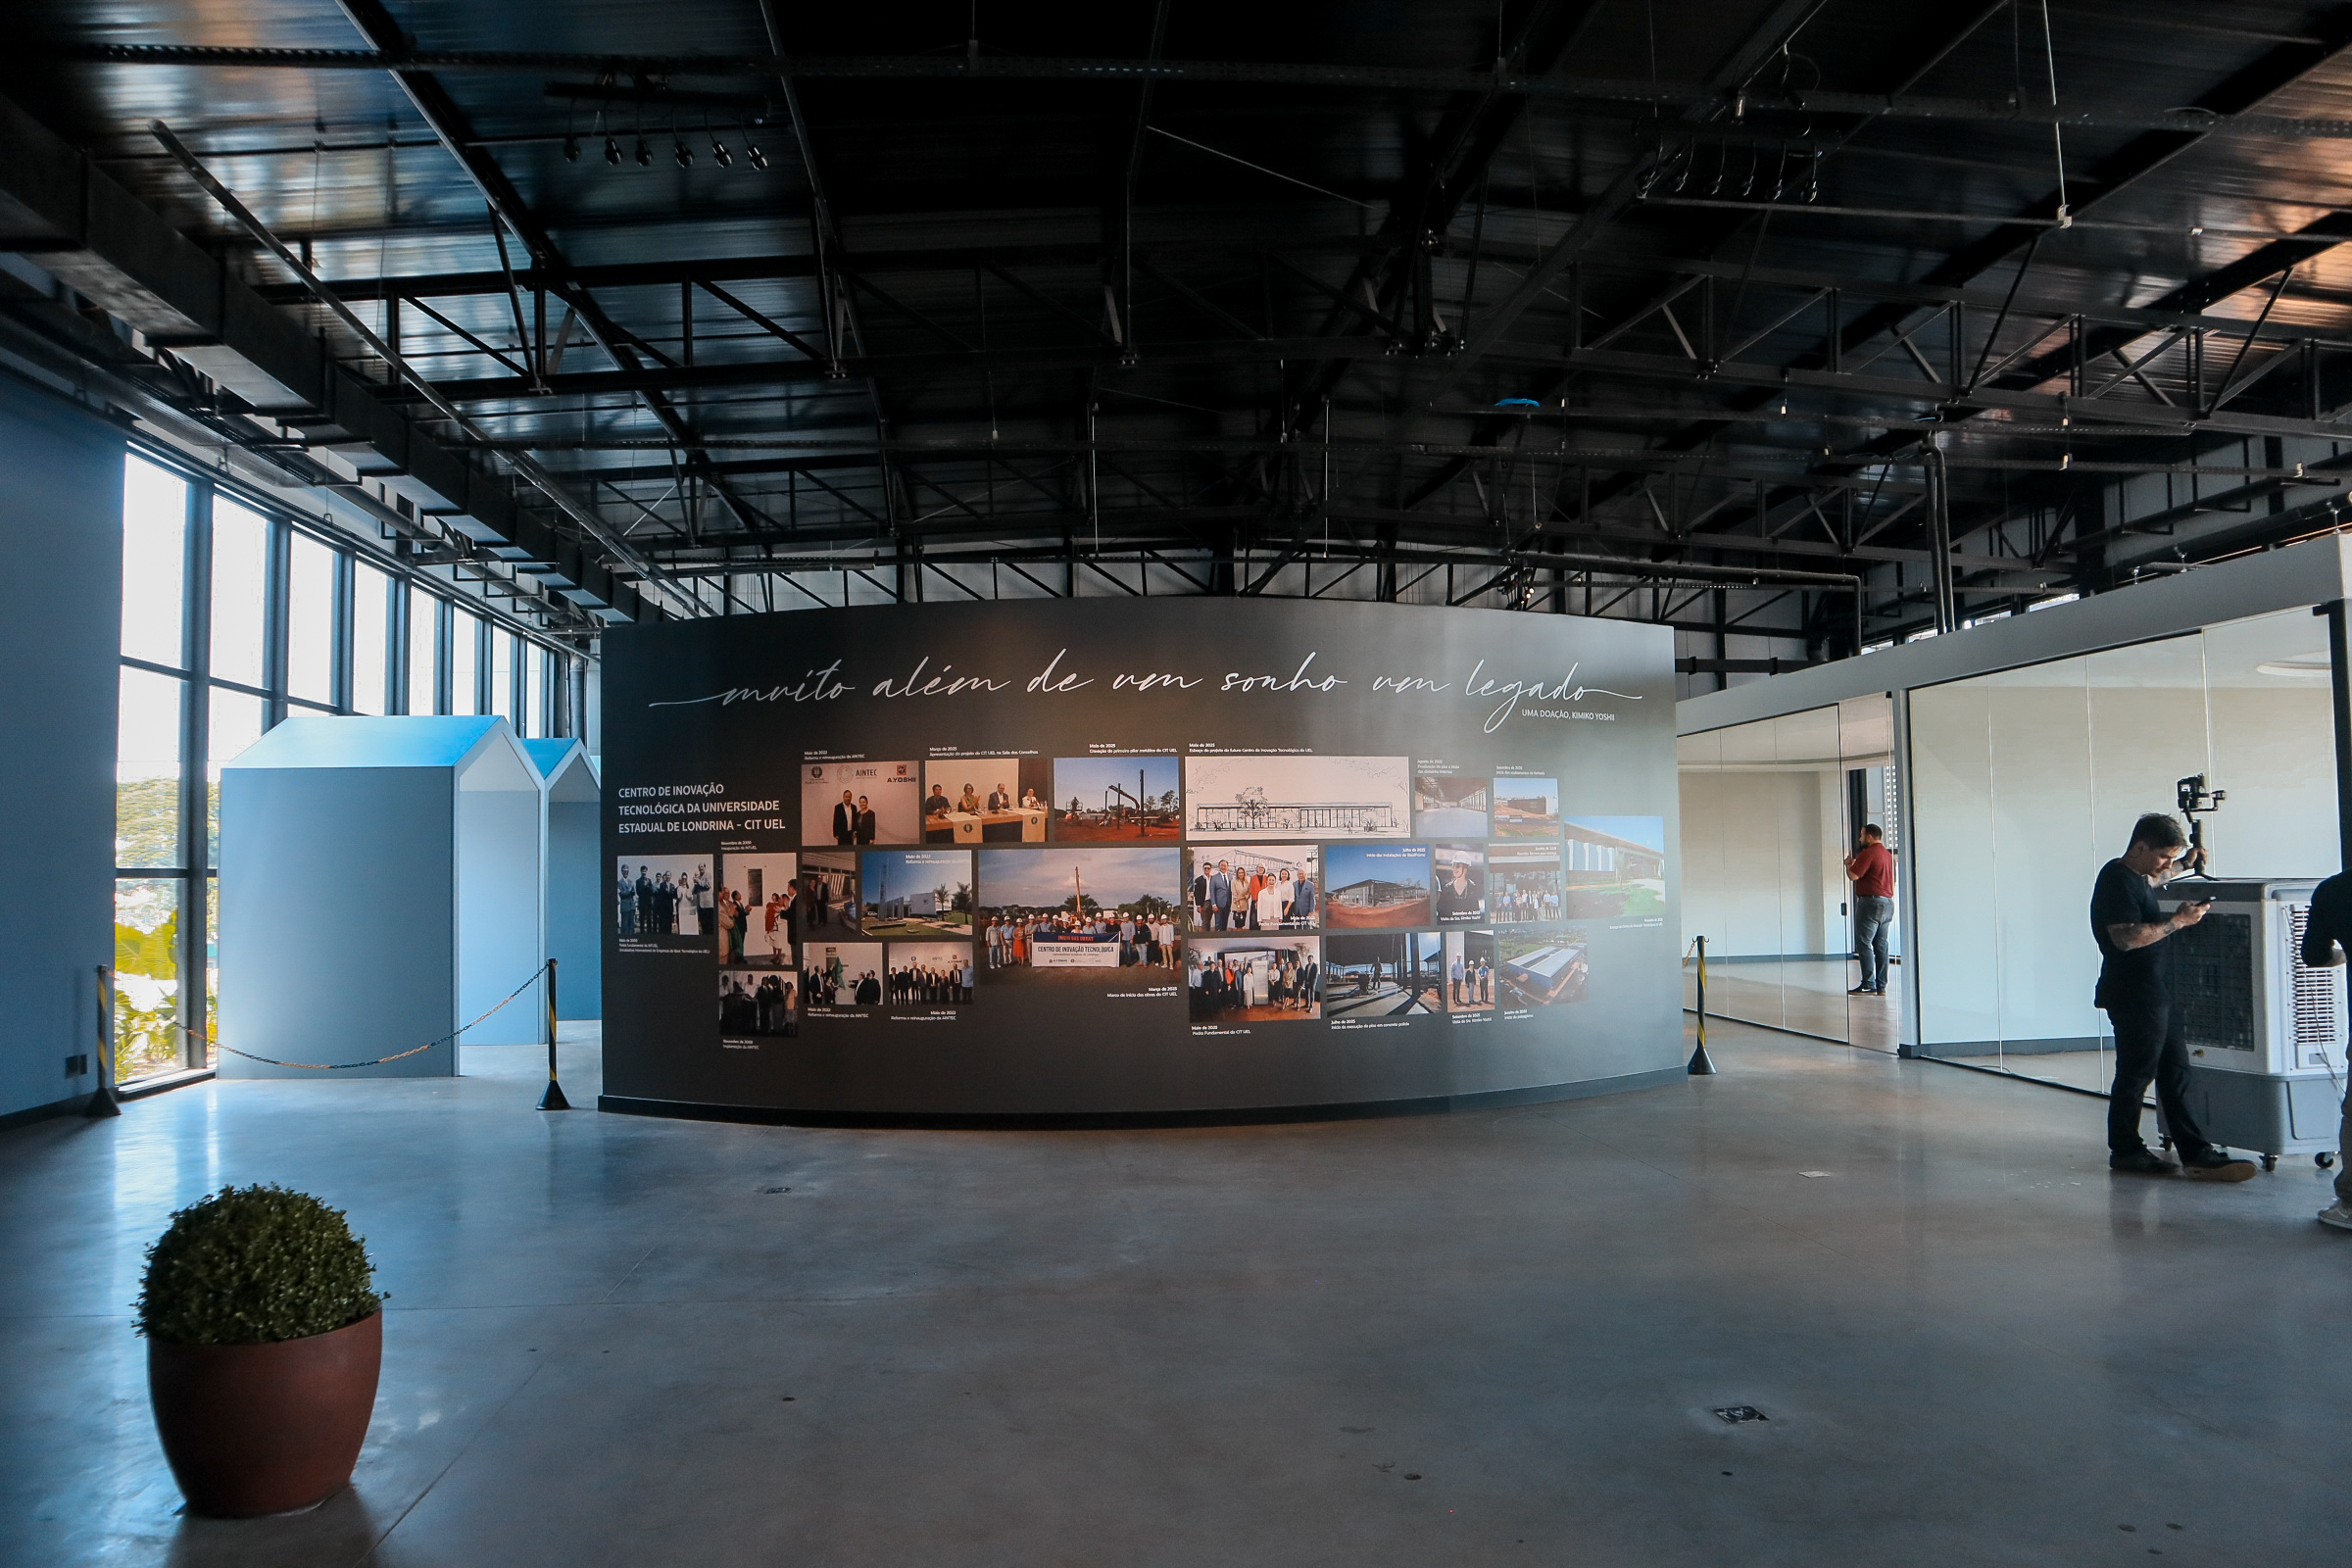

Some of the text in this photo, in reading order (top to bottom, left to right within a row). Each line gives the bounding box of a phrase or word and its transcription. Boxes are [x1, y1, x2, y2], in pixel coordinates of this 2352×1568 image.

[649, 649, 1642, 733] muito além de um sonho um legado
[1521, 709, 1539, 717] UMA
[1540, 709, 1571, 720] DOAÇÃO,
[1572, 711, 1594, 721] KIMIKO
[618, 782, 724, 798] CENTRO DE INOVAÇÃO
[618, 800, 780, 816] TECNOLÓGICA DA UNIVERSIDADE
[618, 822, 665, 834] ESTADUAL
[667, 822, 680, 833] DE
[682, 820, 735, 832] LONDRINA
[744, 819, 761, 831] CIT
[764, 819, 786, 830] UEL
